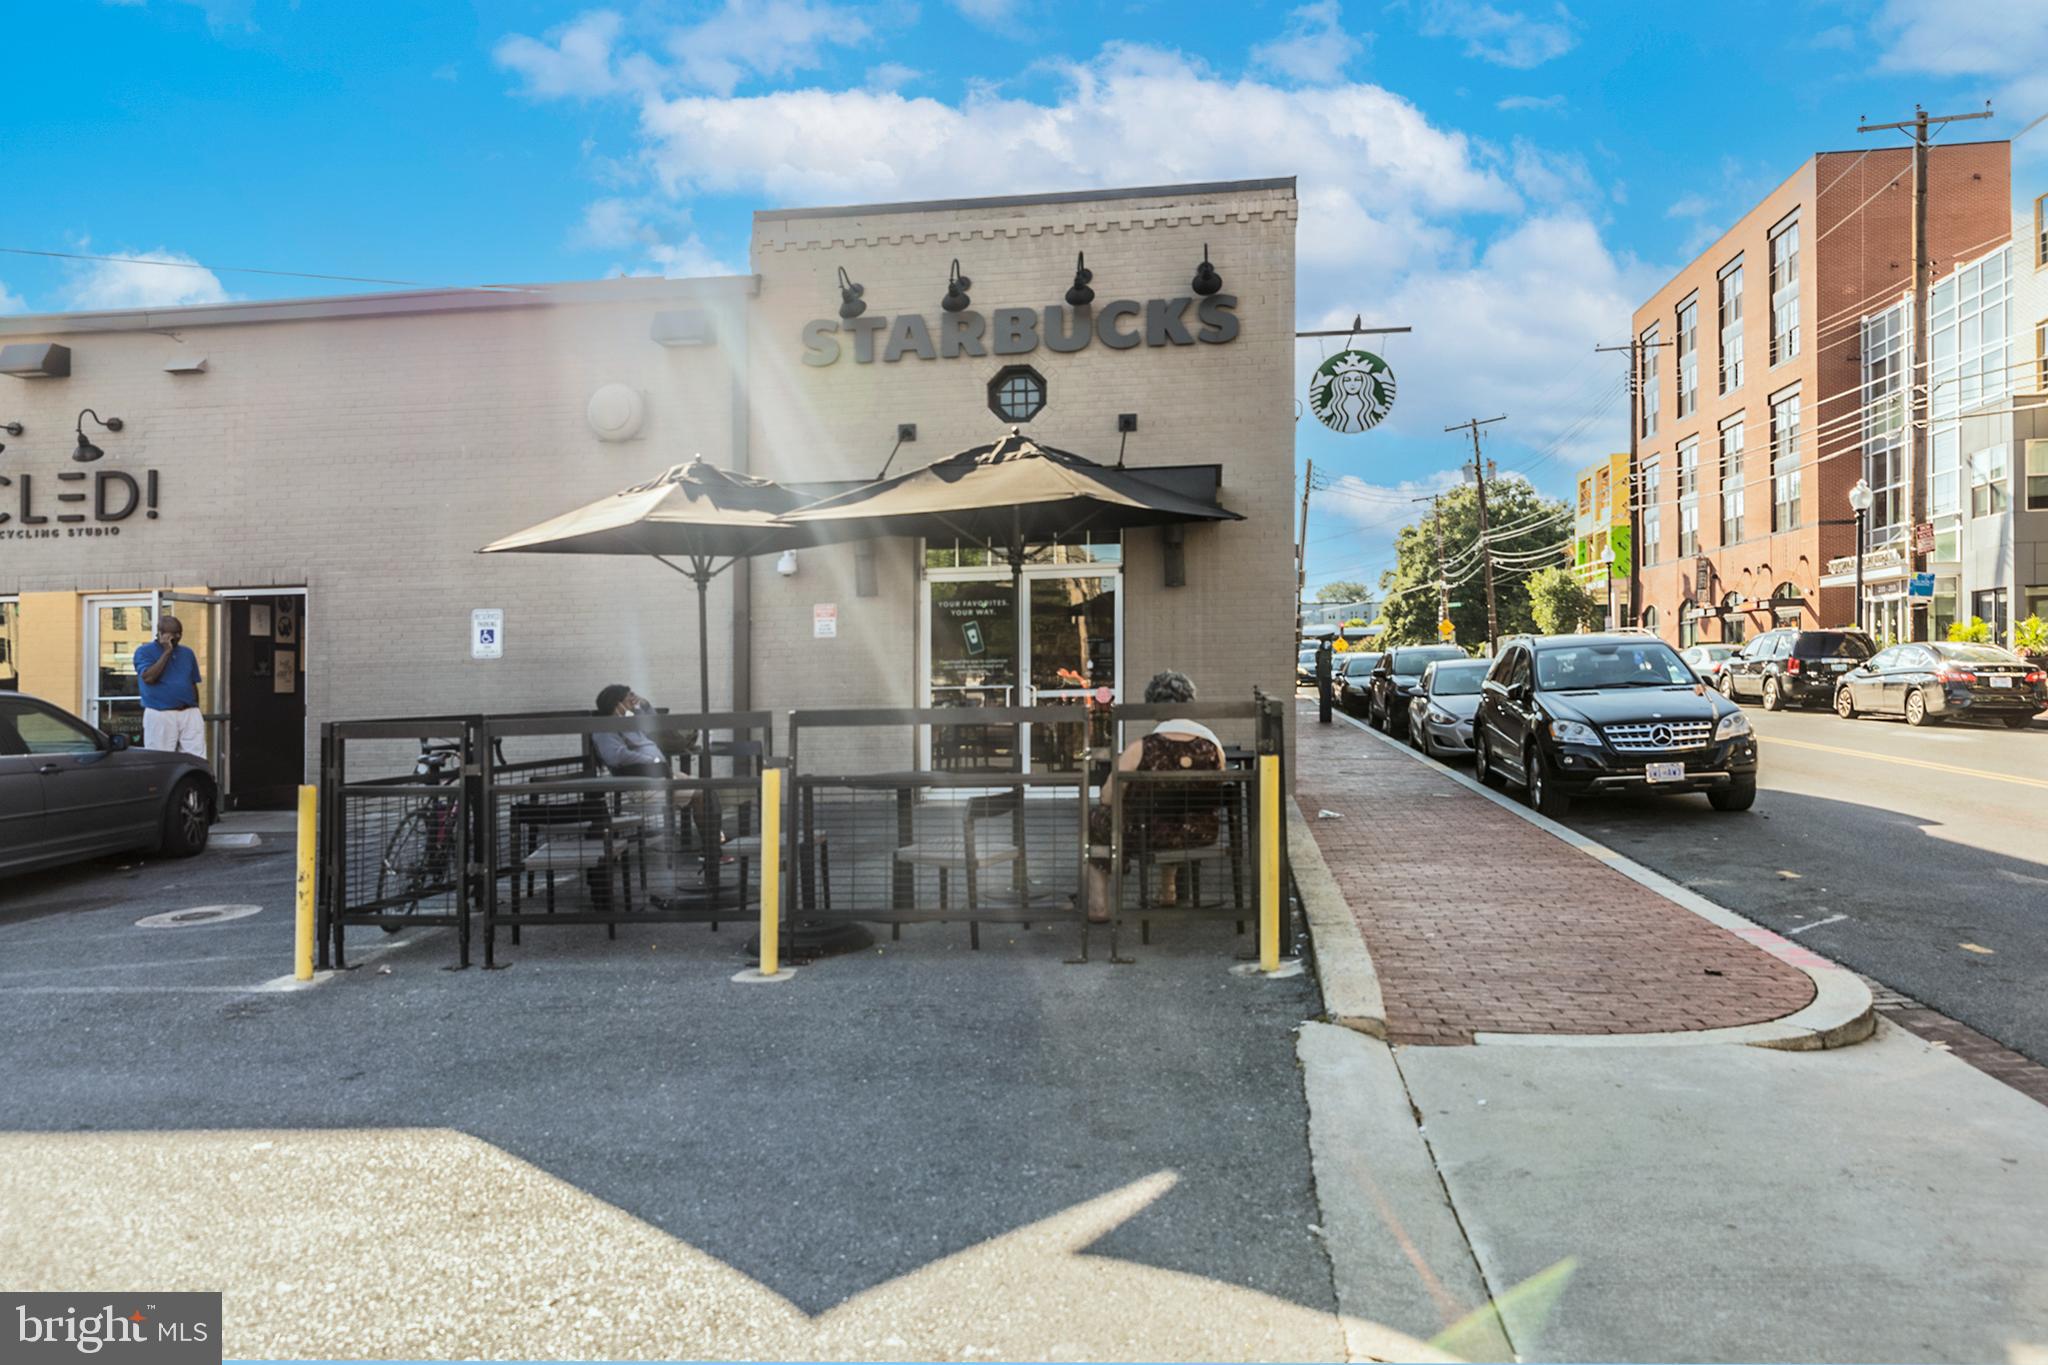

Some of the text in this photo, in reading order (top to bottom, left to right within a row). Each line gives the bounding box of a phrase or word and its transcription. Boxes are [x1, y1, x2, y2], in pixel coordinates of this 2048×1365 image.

[801, 293, 1240, 368] STARBUCKS
[67, 526, 120, 538] STUDIO
[937, 600, 960, 609] YOUR
[950, 608, 997, 617] YOUR WAY.
